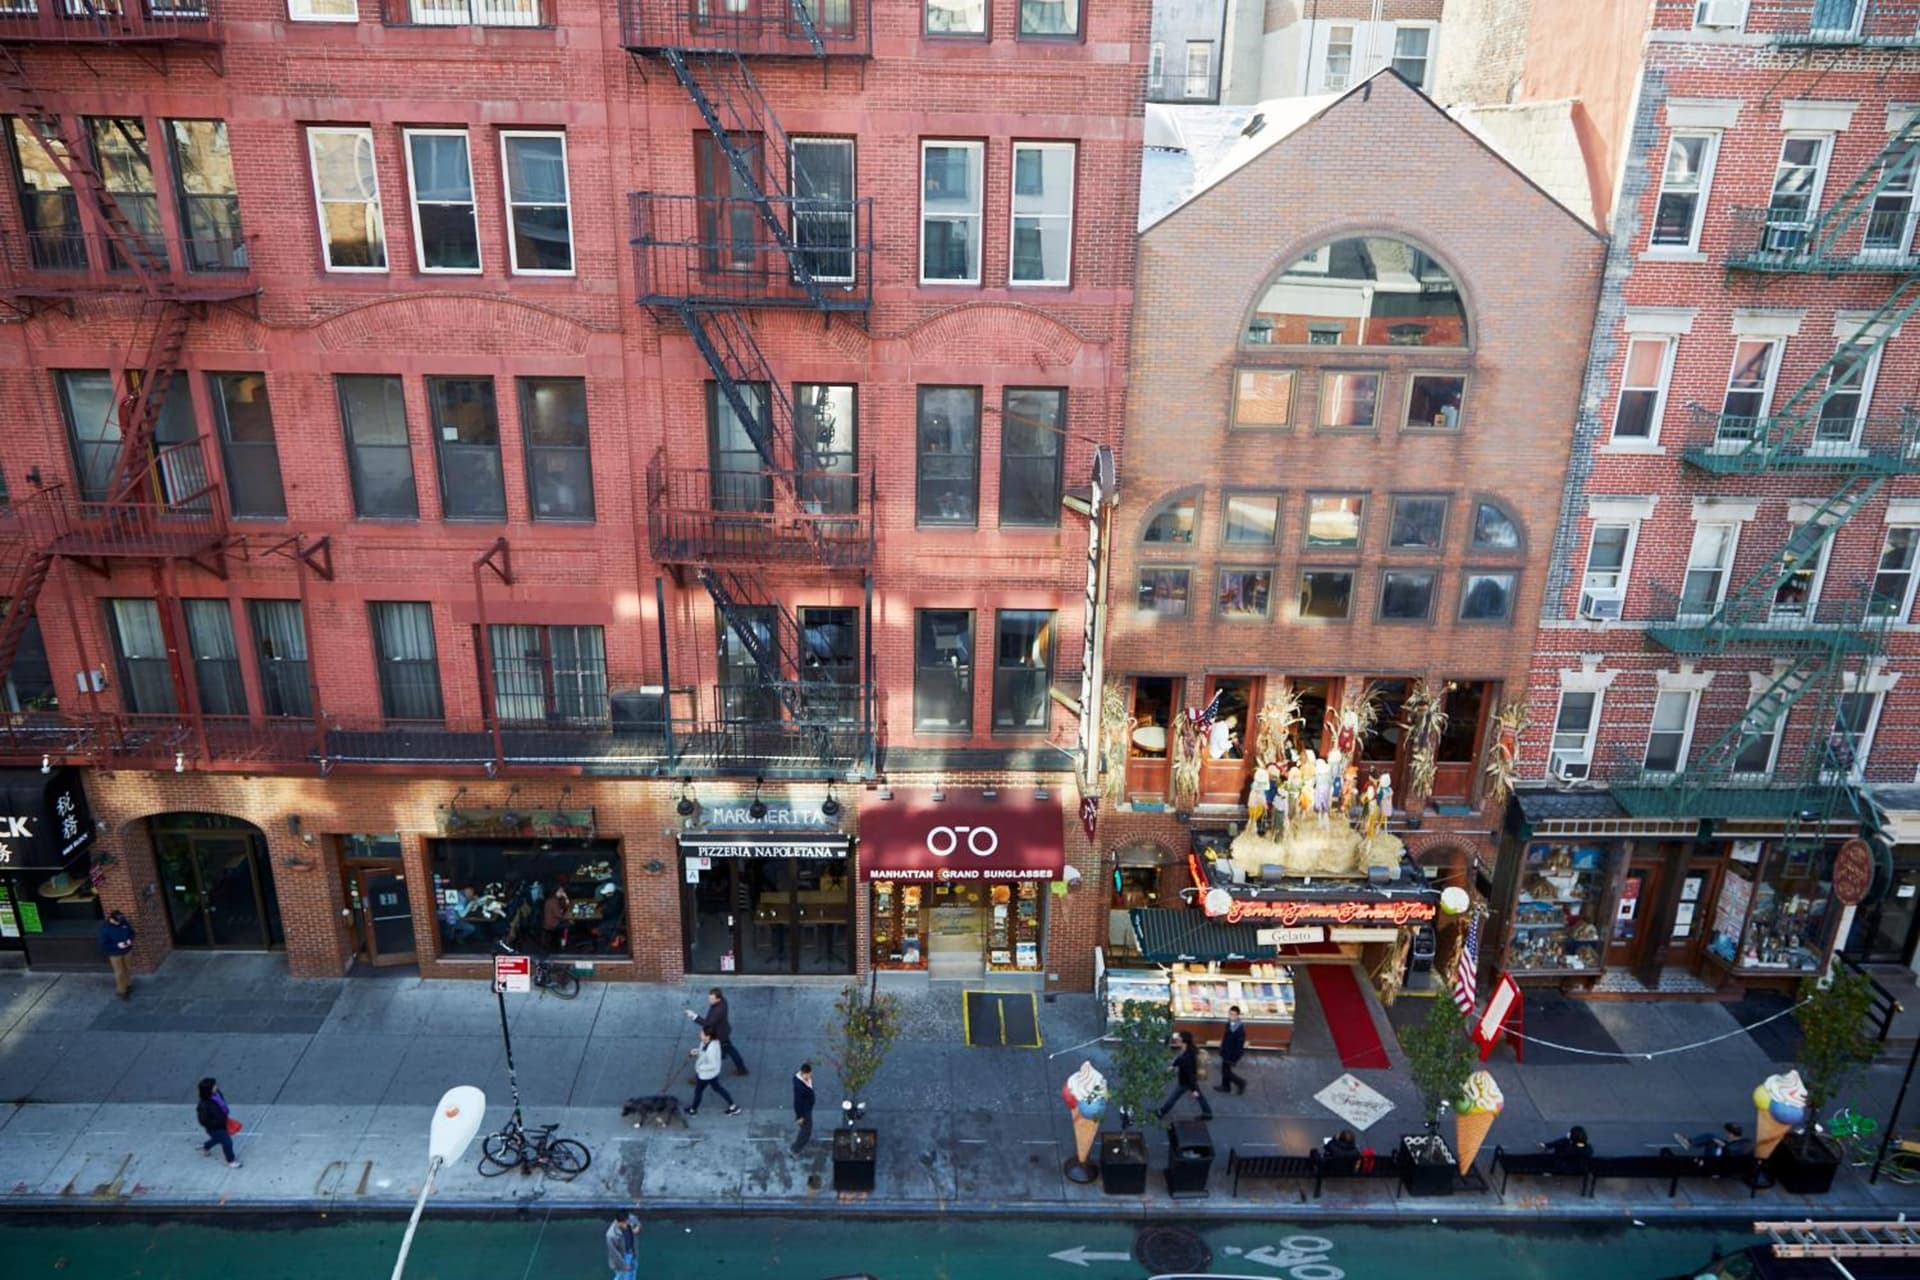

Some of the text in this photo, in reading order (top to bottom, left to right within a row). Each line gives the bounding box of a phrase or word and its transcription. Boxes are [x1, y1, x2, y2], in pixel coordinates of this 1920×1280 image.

[698, 847, 751, 858] PIZZERIA
[755, 847, 833, 858] NAPOLETANA
[870, 870, 1054, 879] MANHATTAN GRAND SUNGLASSES
[1271, 931, 1311, 942] Gelato
